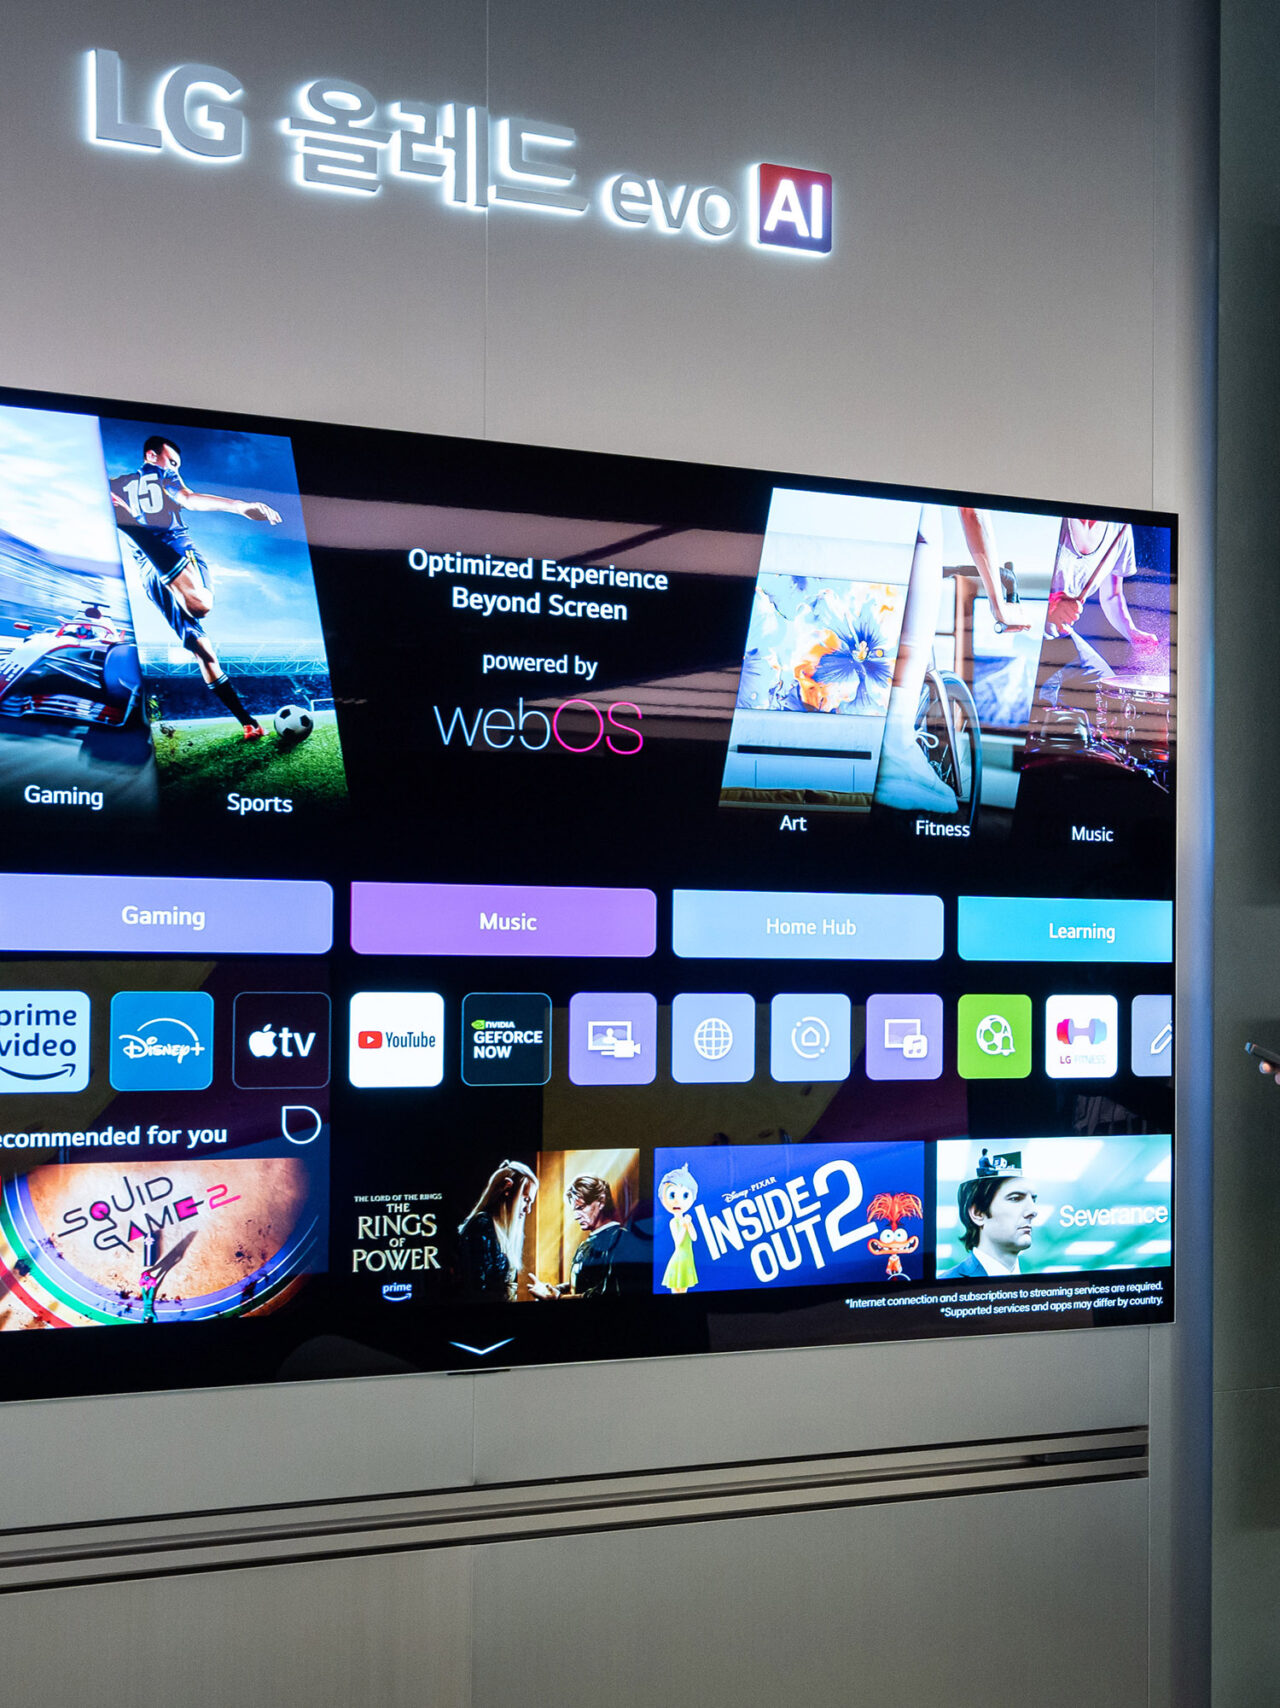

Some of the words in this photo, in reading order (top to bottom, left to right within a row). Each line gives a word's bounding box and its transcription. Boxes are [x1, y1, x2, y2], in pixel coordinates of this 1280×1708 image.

[86, 48, 246, 161] LG
[285, 77, 590, 211] 올레드
[605, 172, 739, 238] evo
[763, 178, 825, 240] AI
[122, 472, 163, 516] 15
[408, 547, 534, 581] Optimized
[541, 559, 669, 591] Experience
[451, 586, 542, 618] Beyond
[548, 593, 629, 621] Screen
[482, 650, 568, 676] powered
[573, 653, 599, 680] by
[433, 696, 645, 756] webOS
[24, 783, 105, 811] Gaming
[227, 791, 293, 816] Sports
[780, 814, 808, 832] Art
[915, 819, 971, 838] Fitness
[1071, 825, 1115, 843] Music
[121, 904, 206, 932] Gaming
[479, 911, 538, 932] Music
[766, 917, 818, 936] Home
[822, 918, 858, 937] Hub
[1048, 923, 1116, 944] Learning
[279, 1026, 316, 1058] tv
[385, 1030, 436, 1049] YouTube
[473, 1029, 544, 1046] GEFORCE
[473, 1043, 512, 1060] NOW
[0, 1125, 140, 1149] ecommended
[146, 1126, 182, 1148] for
[186, 1128, 229, 1149] you
[386, 1203, 411, 1214] THE
[812, 1159, 878, 1252] 2
[1059, 1203, 1169, 1229] Severance
[358, 1213, 438, 1240] RINGS
[696, 1175, 821, 1262] INSIDE
[388, 1237, 406, 1248] OF
[750, 1218, 826, 1284] OUT
[352, 1245, 442, 1273] POWER
[887, 1293, 938, 1306] connection
[940, 1292, 957, 1303] and
[959, 1288, 1017, 1303] subscriptions
[1019, 1289, 1029, 1298] to
[1030, 1286, 1073, 1298] streaming
[1074, 1284, 1110, 1295] services
[1111, 1284, 1126, 1293] are
[1126, 1281, 1163, 1293] required.
[993, 1303, 1030, 1314] services
[1031, 1301, 1049, 1312] and
[1050, 1300, 1073, 1312] apps
[1073, 1300, 1093, 1311] may
[1093, 1297, 1116, 1308] differ
[1117, 1297, 1129, 1308] by
[1129, 1295, 1163, 1307] country.
